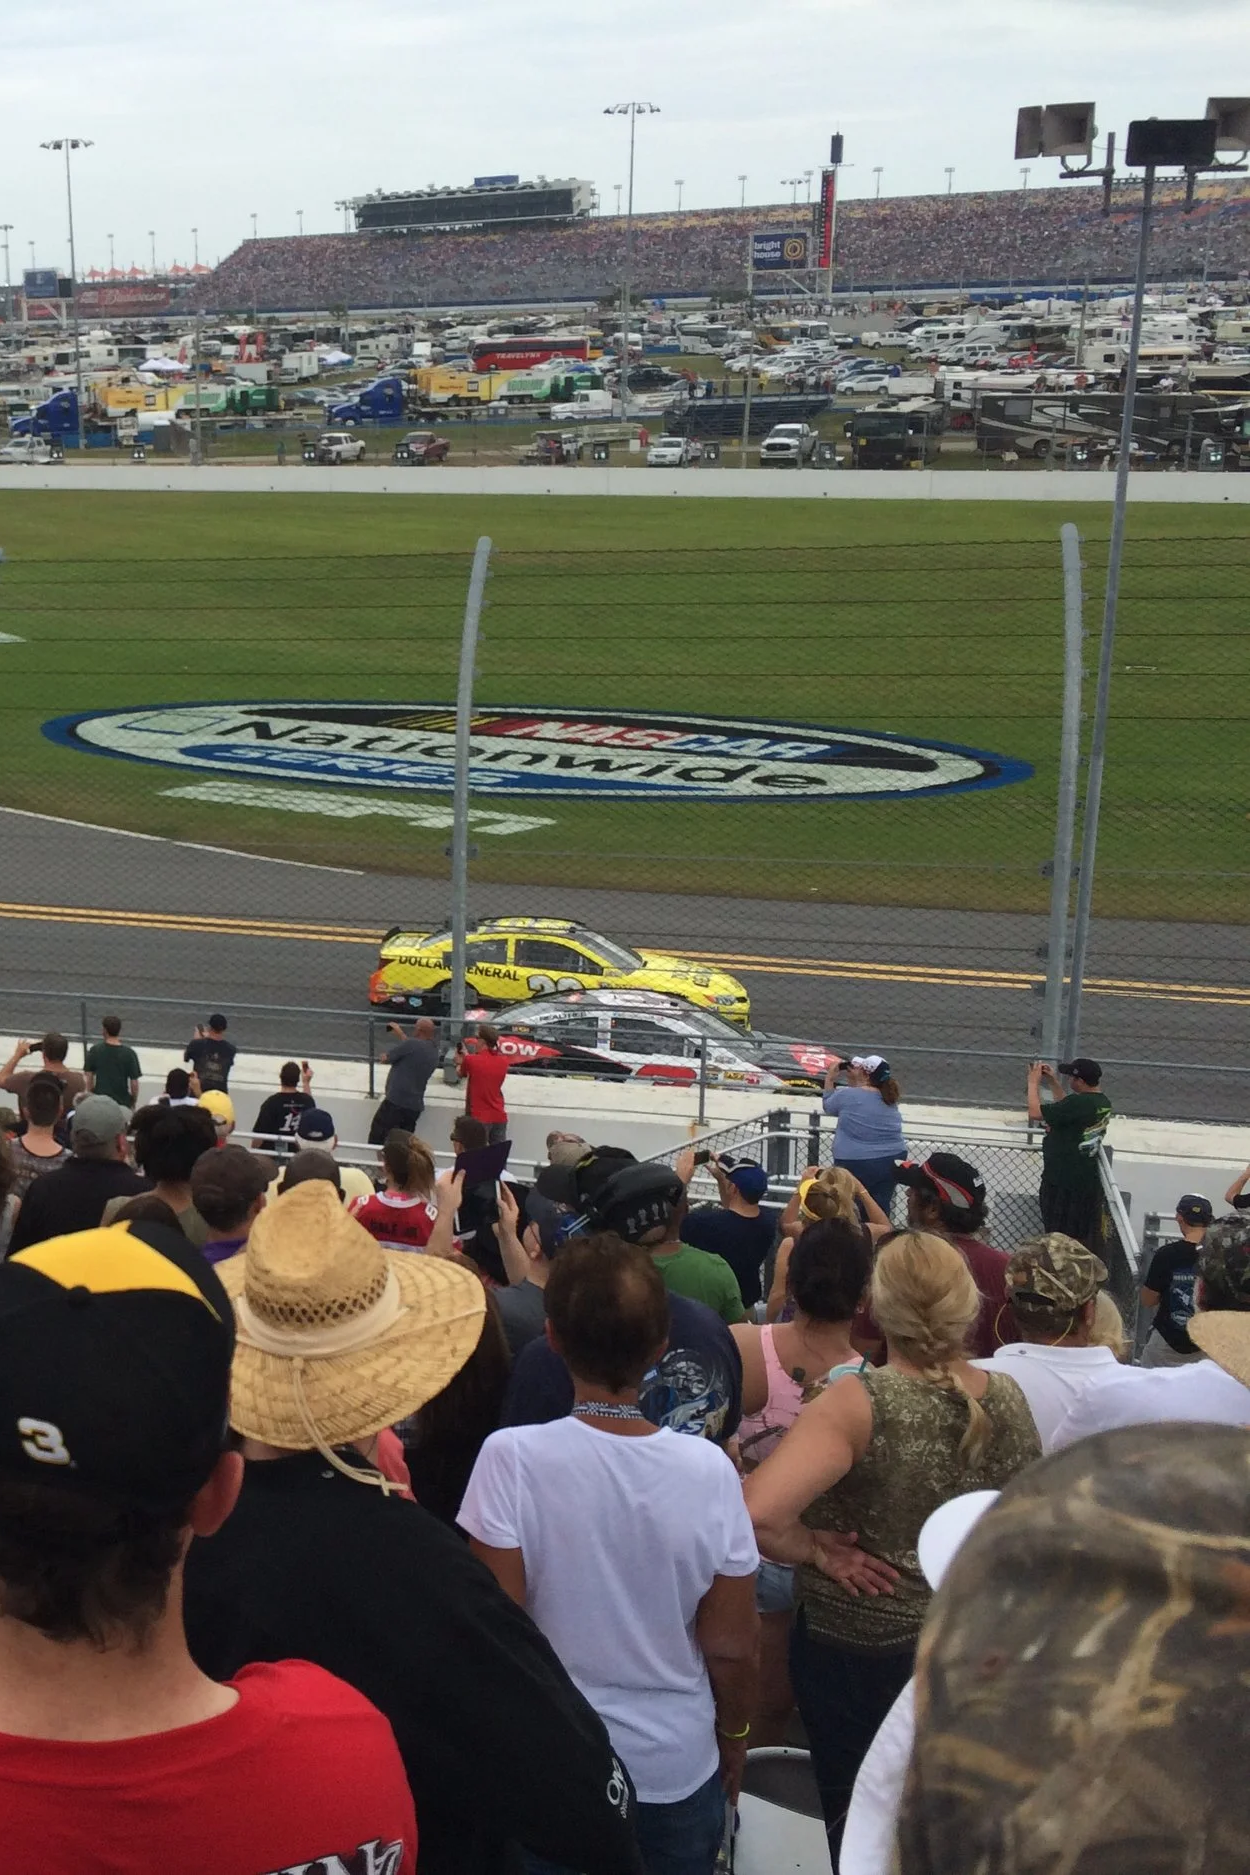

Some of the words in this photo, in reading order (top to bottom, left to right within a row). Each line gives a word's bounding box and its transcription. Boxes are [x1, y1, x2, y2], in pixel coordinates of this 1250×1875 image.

[754, 241, 781, 250] bright
[216, 721, 828, 789] Nationwide
[505, 721, 833, 758] NASCAR
[213, 748, 520, 785] SERIES
[466, 965, 520, 981] ENERAL
[499, 1041, 541, 1056] OW
[17, 1417, 70, 1465] 3
